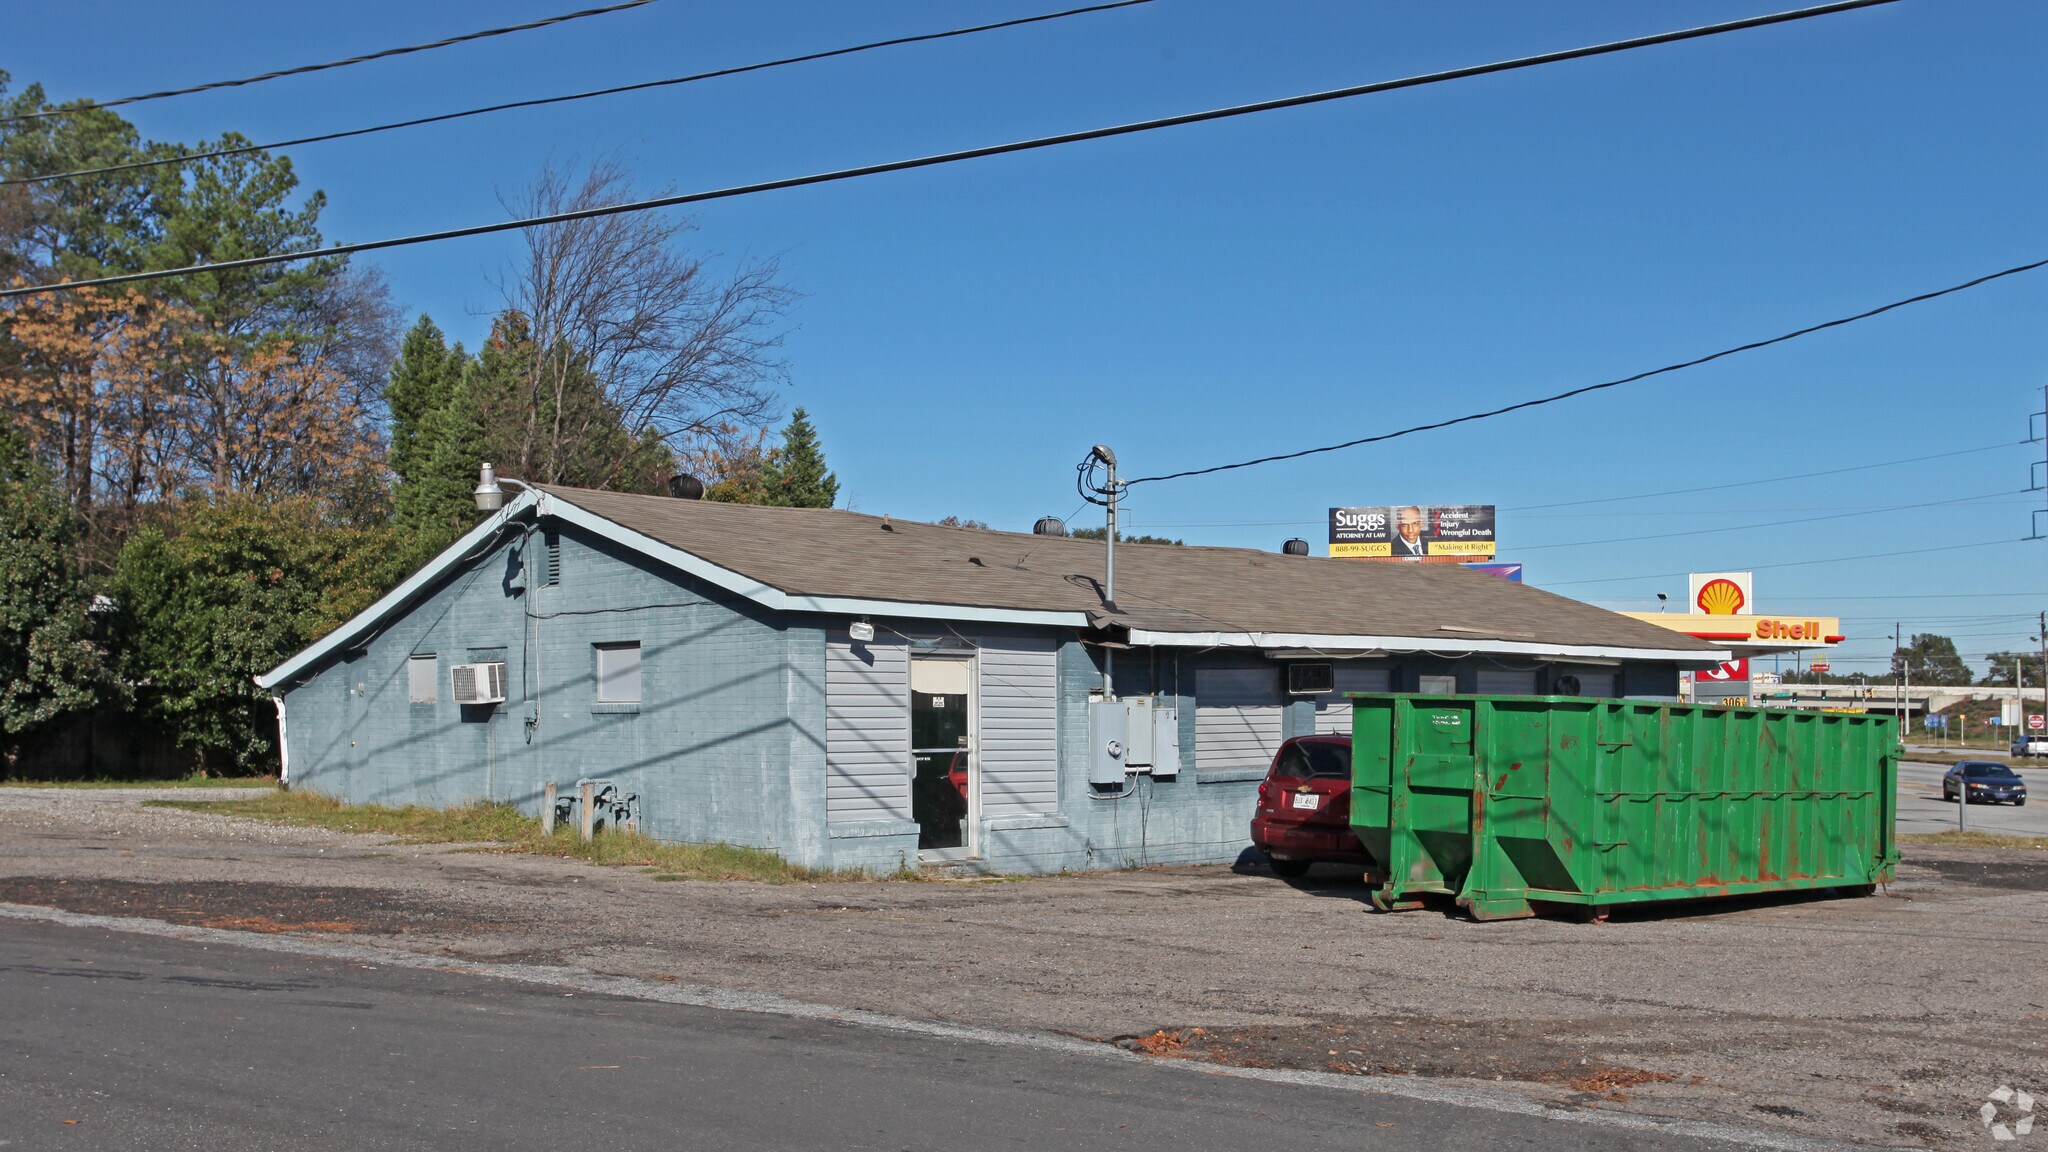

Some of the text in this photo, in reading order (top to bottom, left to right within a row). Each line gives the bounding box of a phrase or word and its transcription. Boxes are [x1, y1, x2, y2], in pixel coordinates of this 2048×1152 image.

[1440, 511, 1469, 519] Accident
[1335, 510, 1386, 531] Suggs
[1440, 521, 1460, 529] Injury
[1440, 529, 1471, 538] Wrongful
[1335, 544, 1387, 552] 888-99-SUGGS
[1756, 619, 1820, 640] Shell
